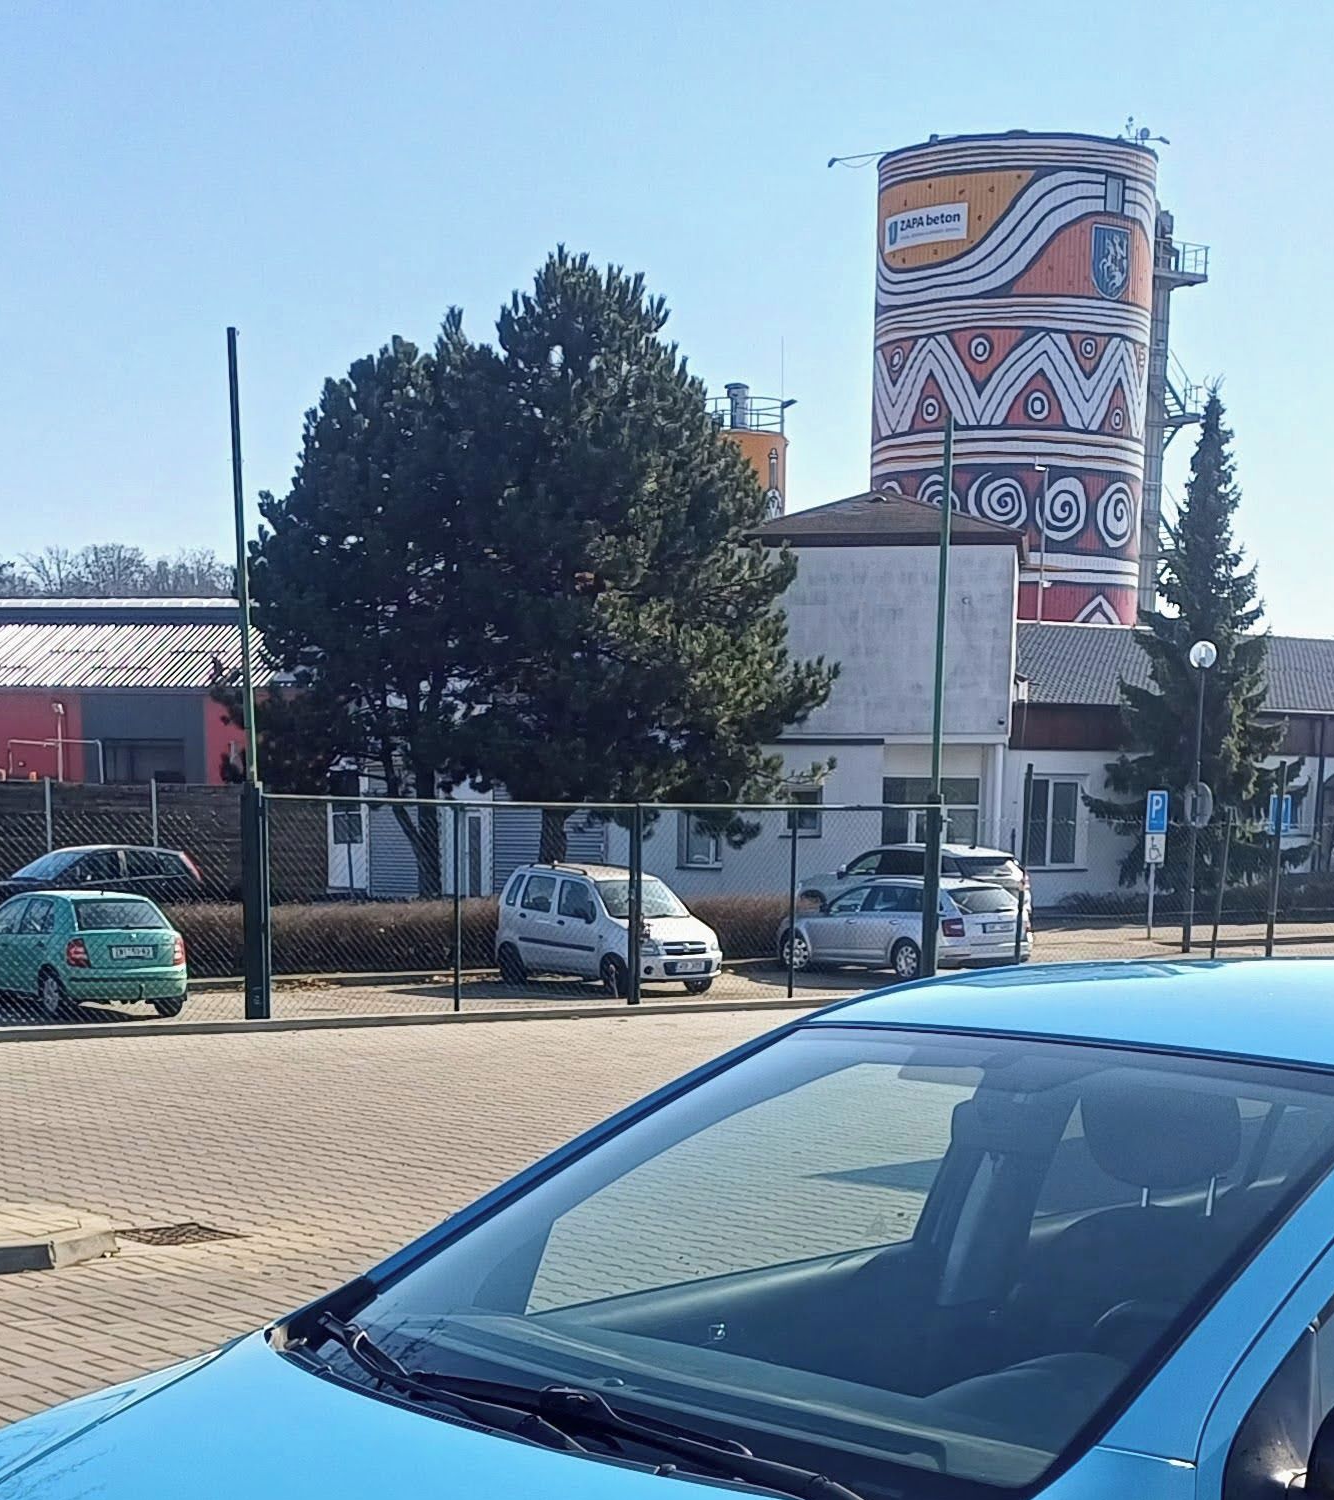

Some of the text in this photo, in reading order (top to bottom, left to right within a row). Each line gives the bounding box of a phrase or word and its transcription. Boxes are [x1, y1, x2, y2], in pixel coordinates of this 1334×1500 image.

[900, 213, 961, 232] ZAPA beton
[1152, 795, 1163, 819] P
